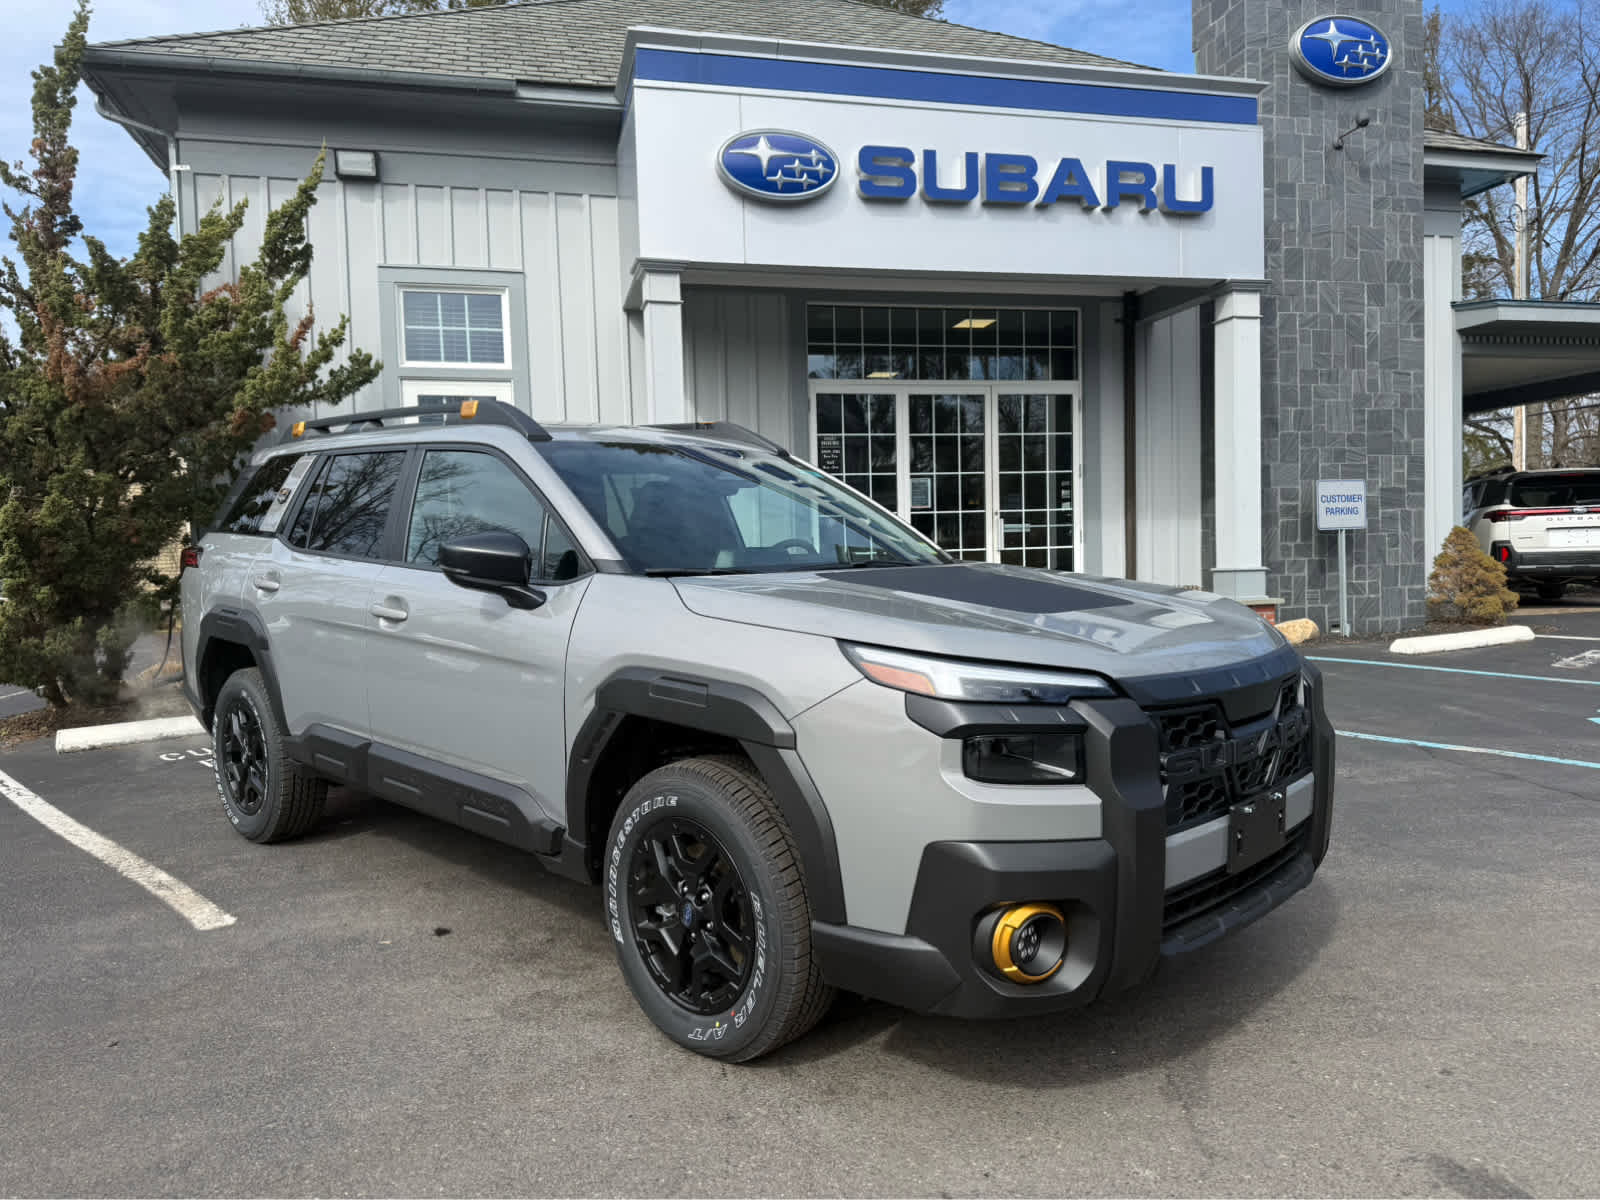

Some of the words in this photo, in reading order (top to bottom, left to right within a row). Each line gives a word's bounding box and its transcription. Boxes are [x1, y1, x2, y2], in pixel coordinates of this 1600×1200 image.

[857, 144, 1215, 213] SUBARU
[1320, 493, 1363, 504] CUSTOMER
[1325, 506, 1360, 517] PARKING
[687, 1023, 728, 1041] A/T
